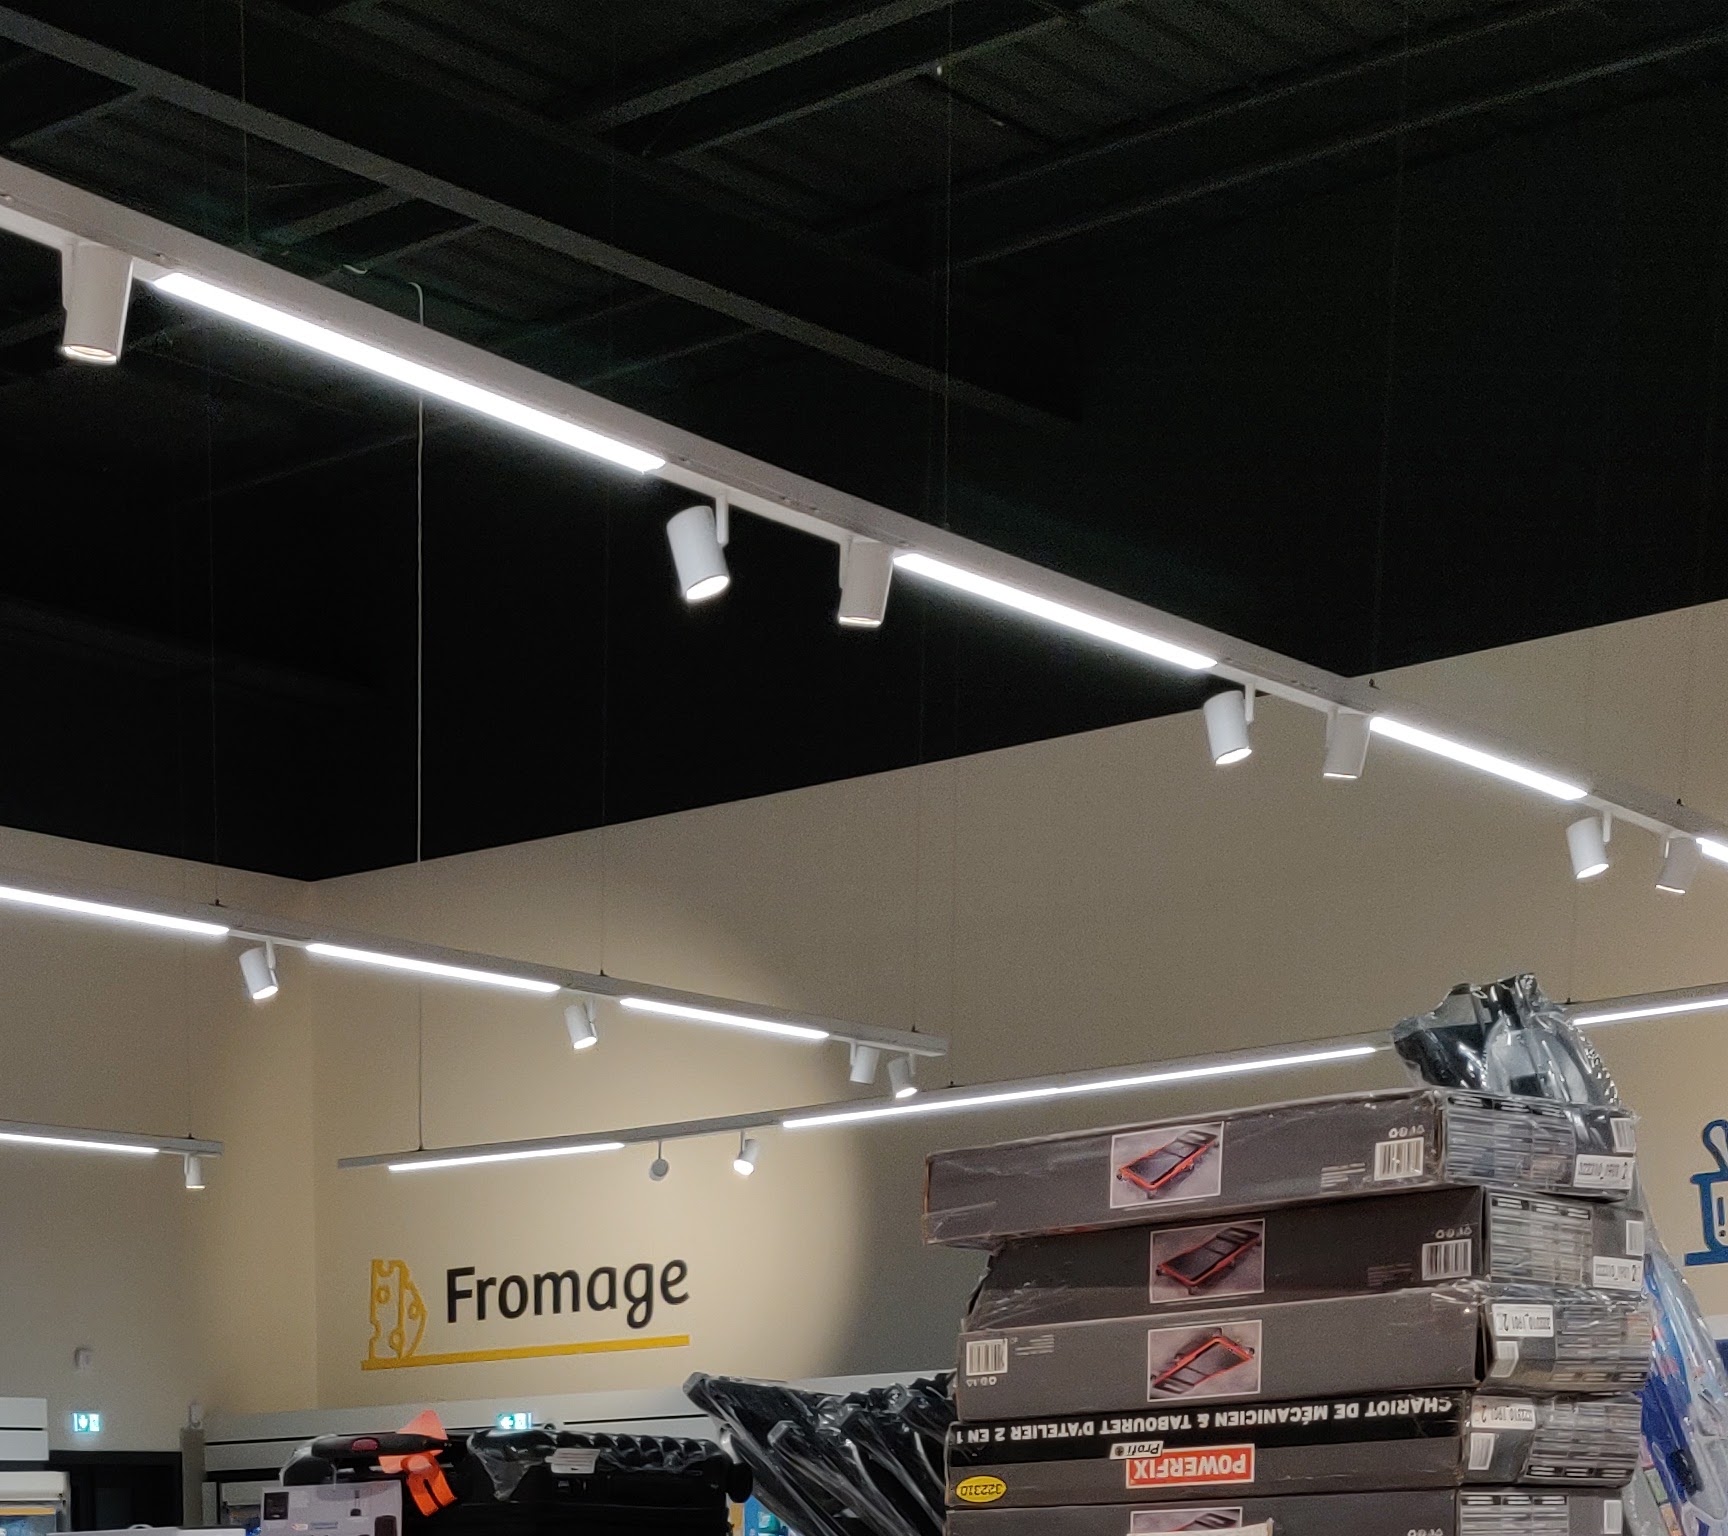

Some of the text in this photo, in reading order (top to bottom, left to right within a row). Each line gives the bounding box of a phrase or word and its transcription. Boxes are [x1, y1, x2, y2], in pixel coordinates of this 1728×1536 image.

[446, 1258, 690, 1329] Fromage
[955, 1397, 1453, 1444] CHARIOT DE MÉCANICIEN & TABOURET D'ATELIER 2 EN 1
[1126, 1442, 1162, 1457] Profi
[1132, 1453, 1246, 1481] POWERFIX
[959, 1481, 1003, 1498] 322310
